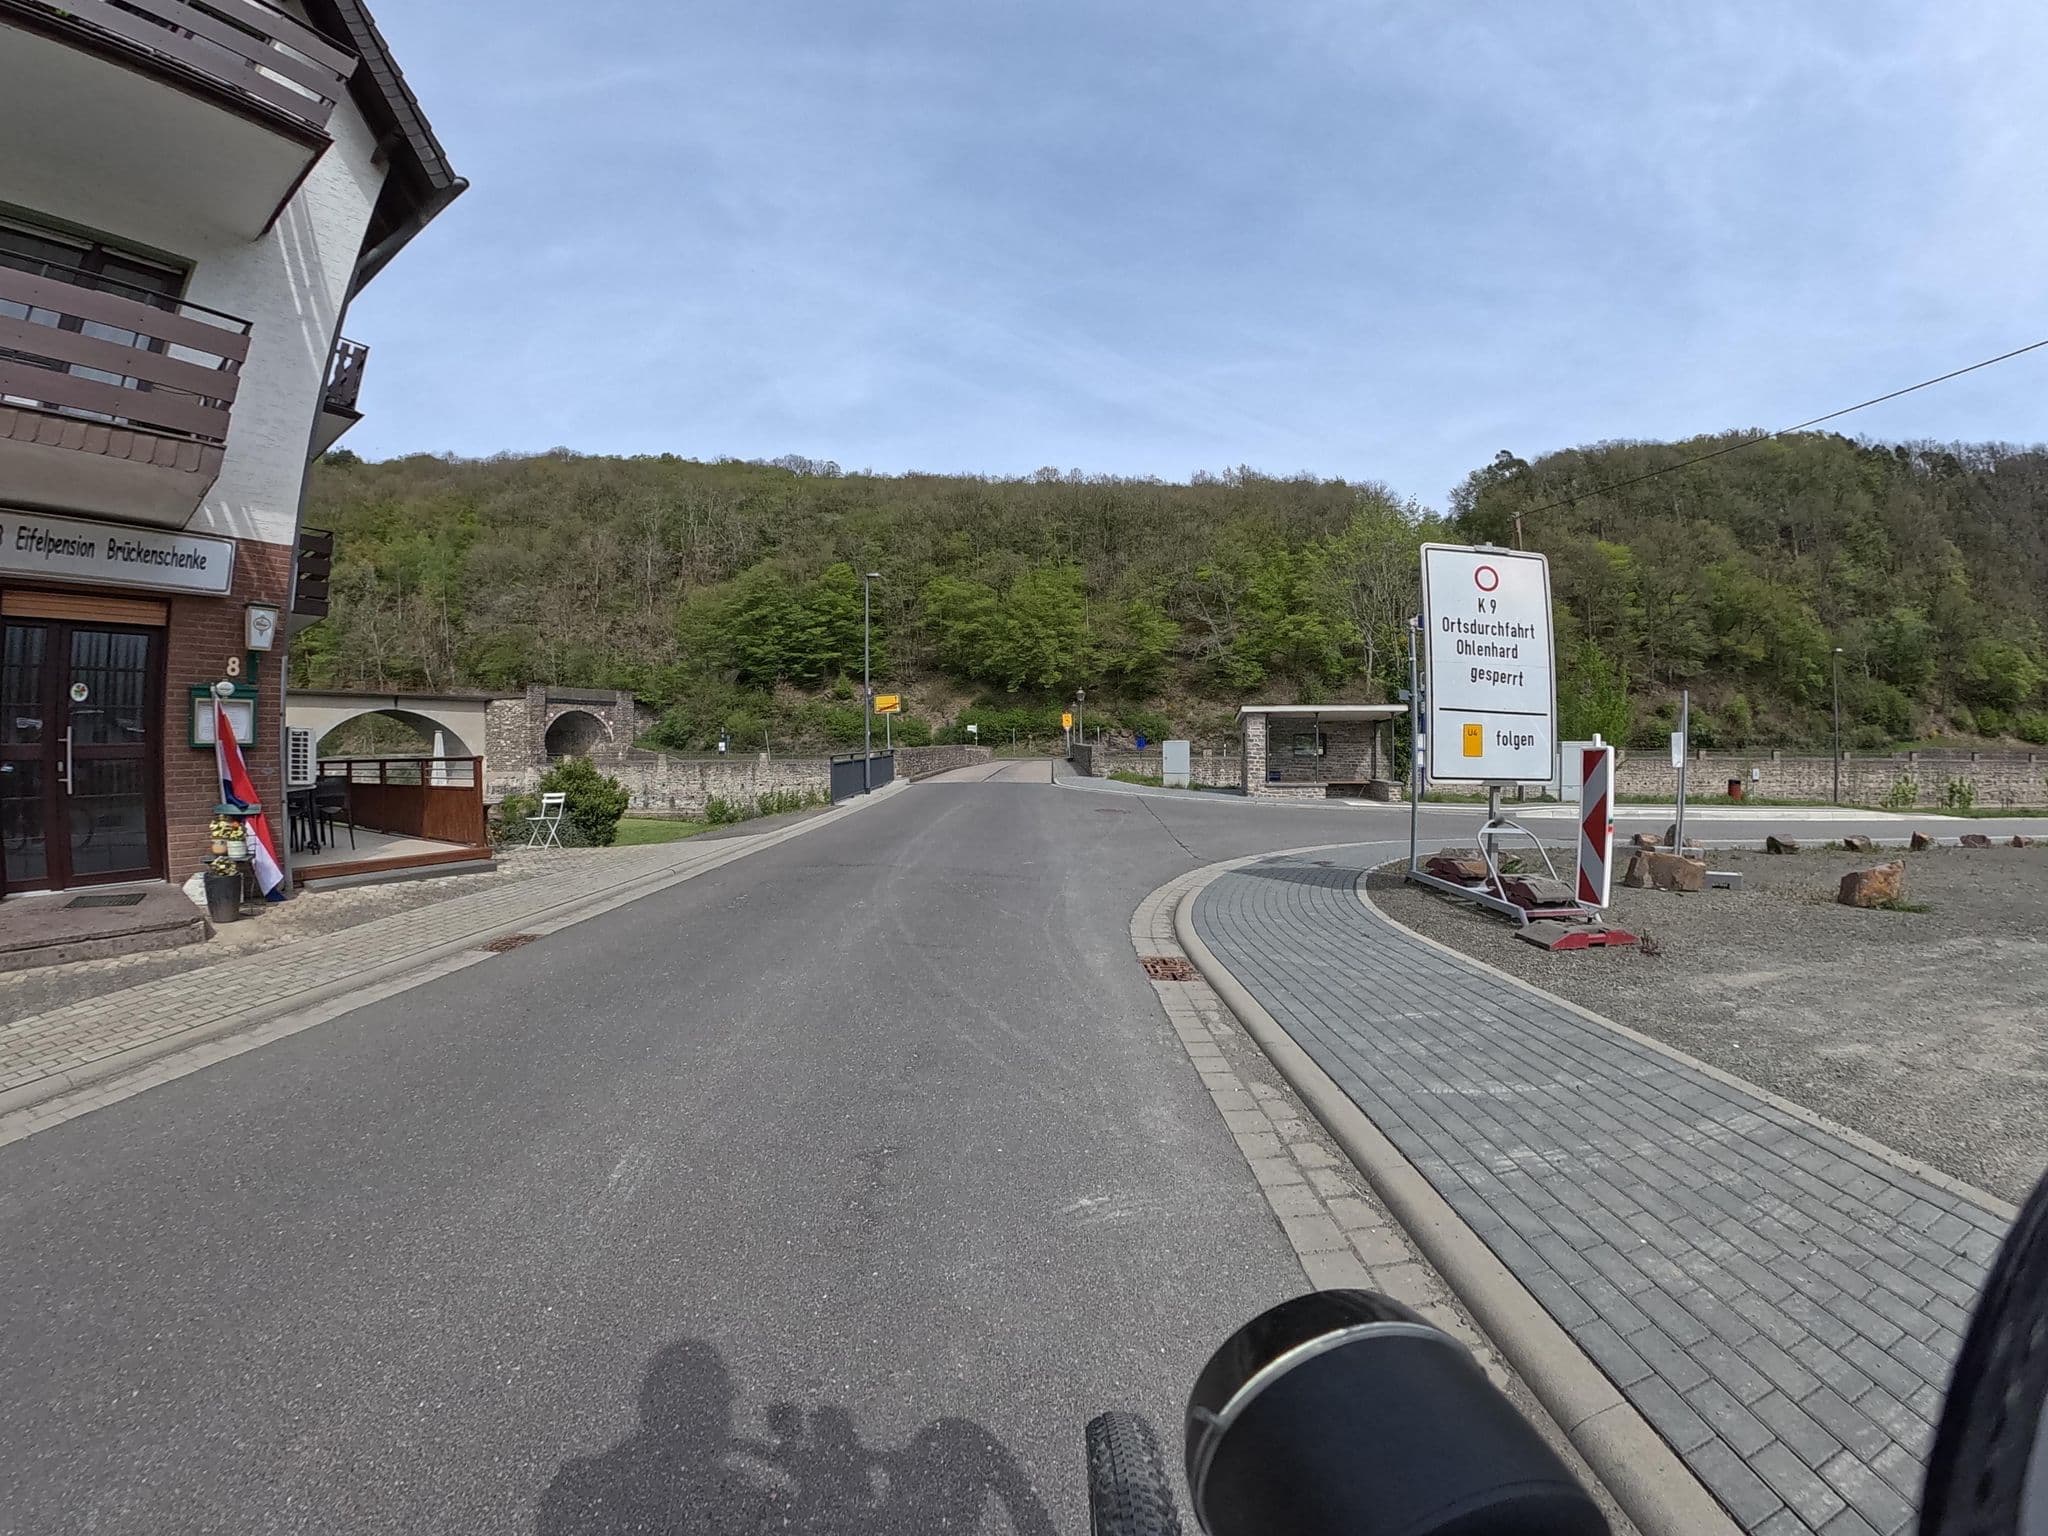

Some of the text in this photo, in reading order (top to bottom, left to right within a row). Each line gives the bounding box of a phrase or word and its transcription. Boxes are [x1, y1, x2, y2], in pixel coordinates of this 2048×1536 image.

[15, 525, 95, 560] Eifelpension
[107, 538, 207, 570] Brückenschenke
[1477, 598, 1497, 614] K 9
[1442, 616, 1535, 639] Ortsdurchfahrt
[1456, 639, 1518, 659] Ohlenhard
[226, 656, 240, 676] 8
[1470, 667, 1523, 686] gesperrt
[1467, 728, 1478, 736] U4
[1496, 730, 1534, 750] folgen
